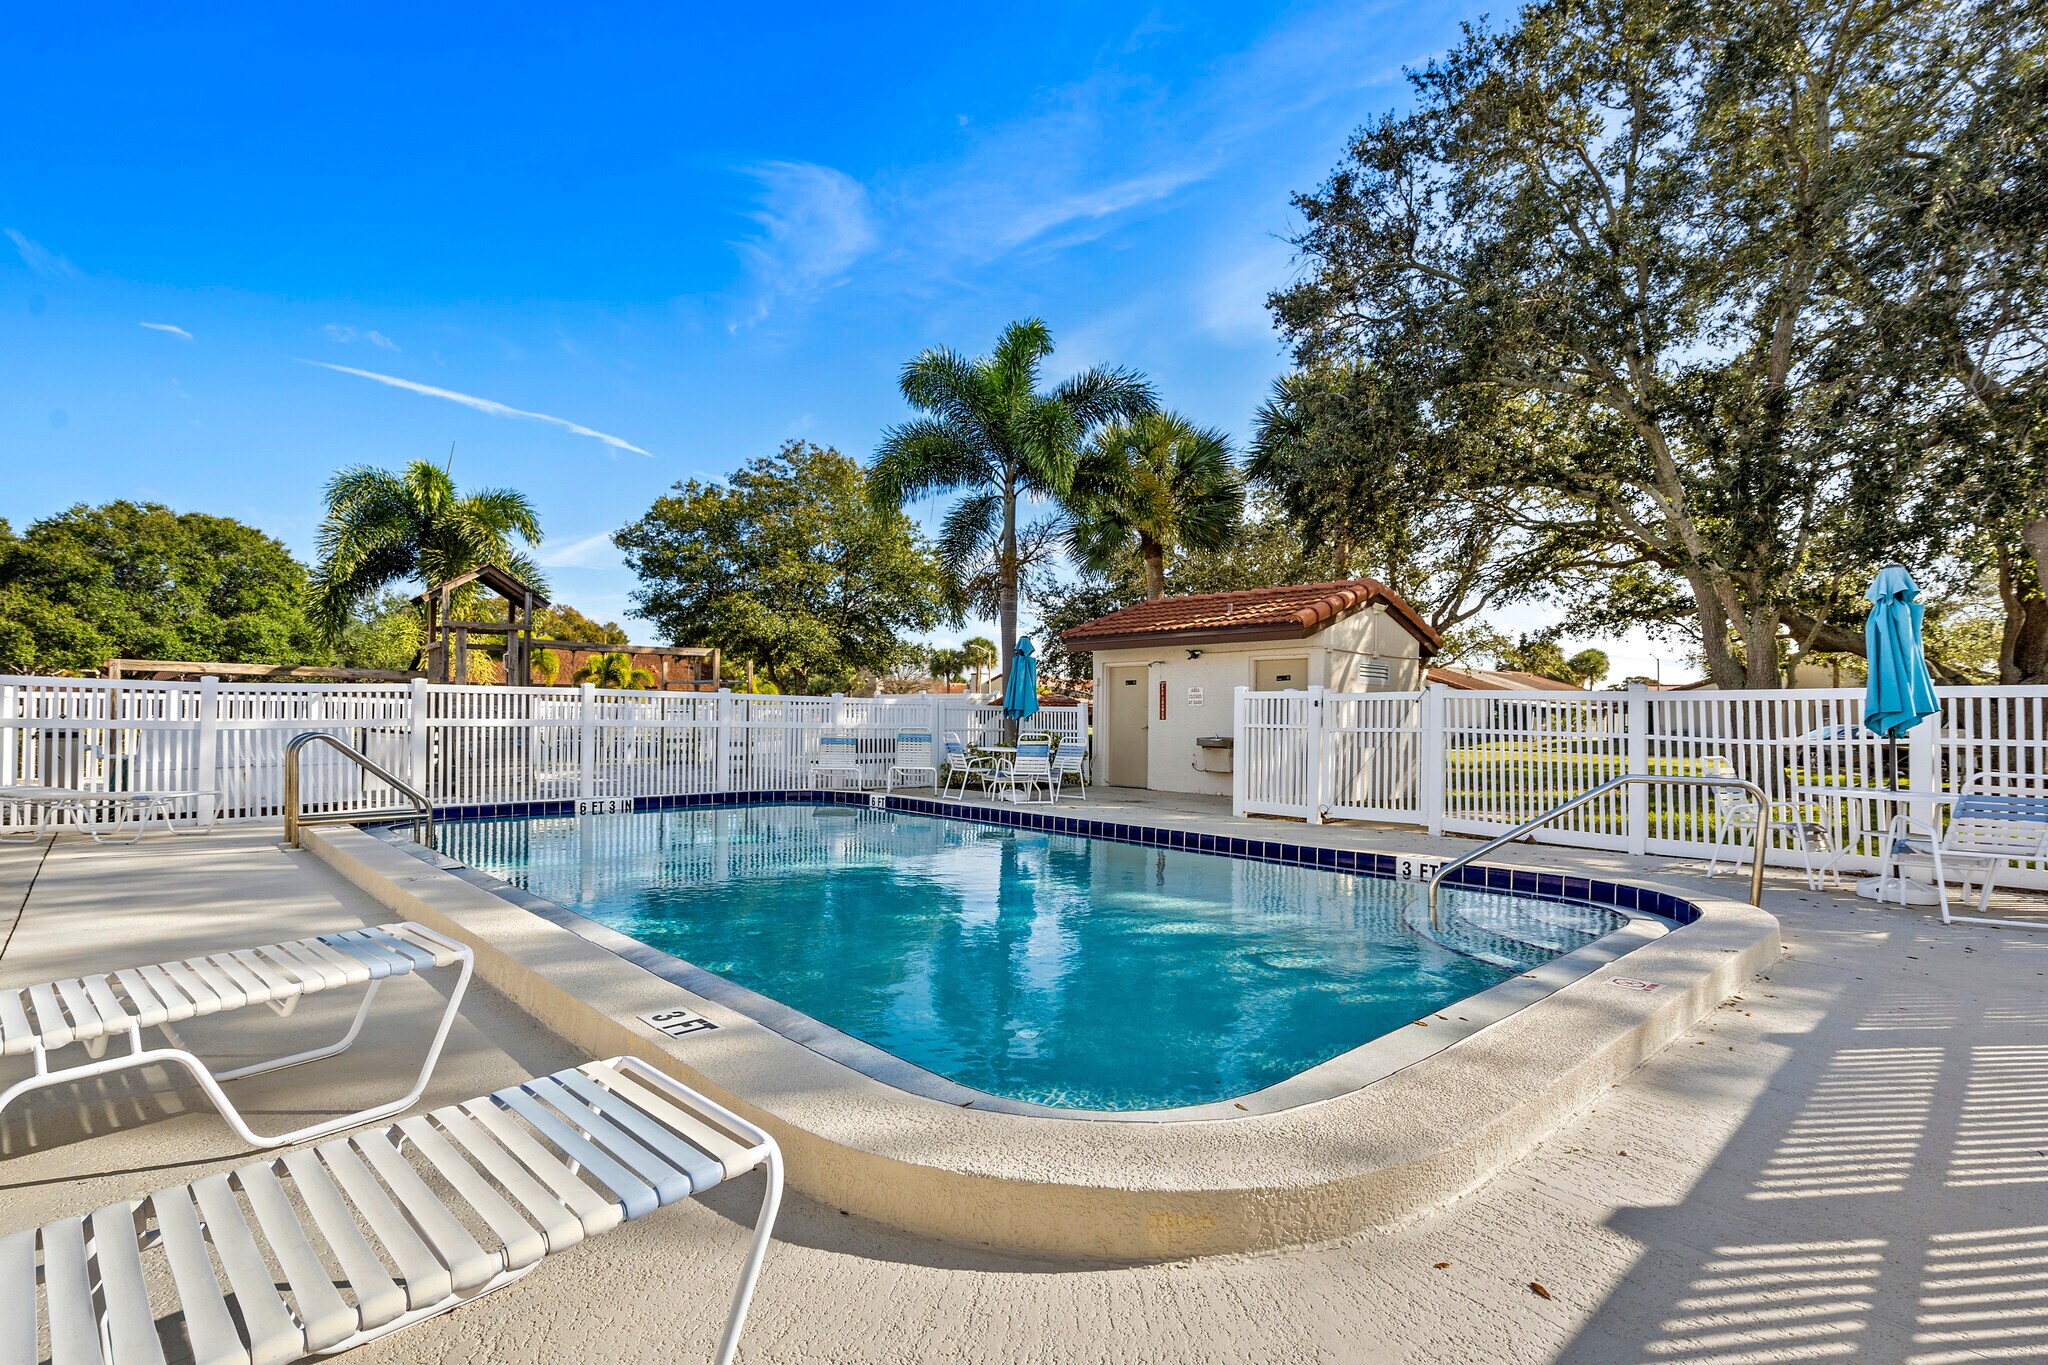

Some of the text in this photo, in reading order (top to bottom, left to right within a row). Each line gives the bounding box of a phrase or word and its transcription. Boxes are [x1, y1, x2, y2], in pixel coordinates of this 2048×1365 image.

[580, 802, 587, 813] 6
[609, 800, 616, 813] 3
[621, 800, 632, 813] IN
[871, 797, 876, 807] 6
[1402, 861, 1439, 880] 3 FT
[652, 1011, 720, 1036] 3 FT
